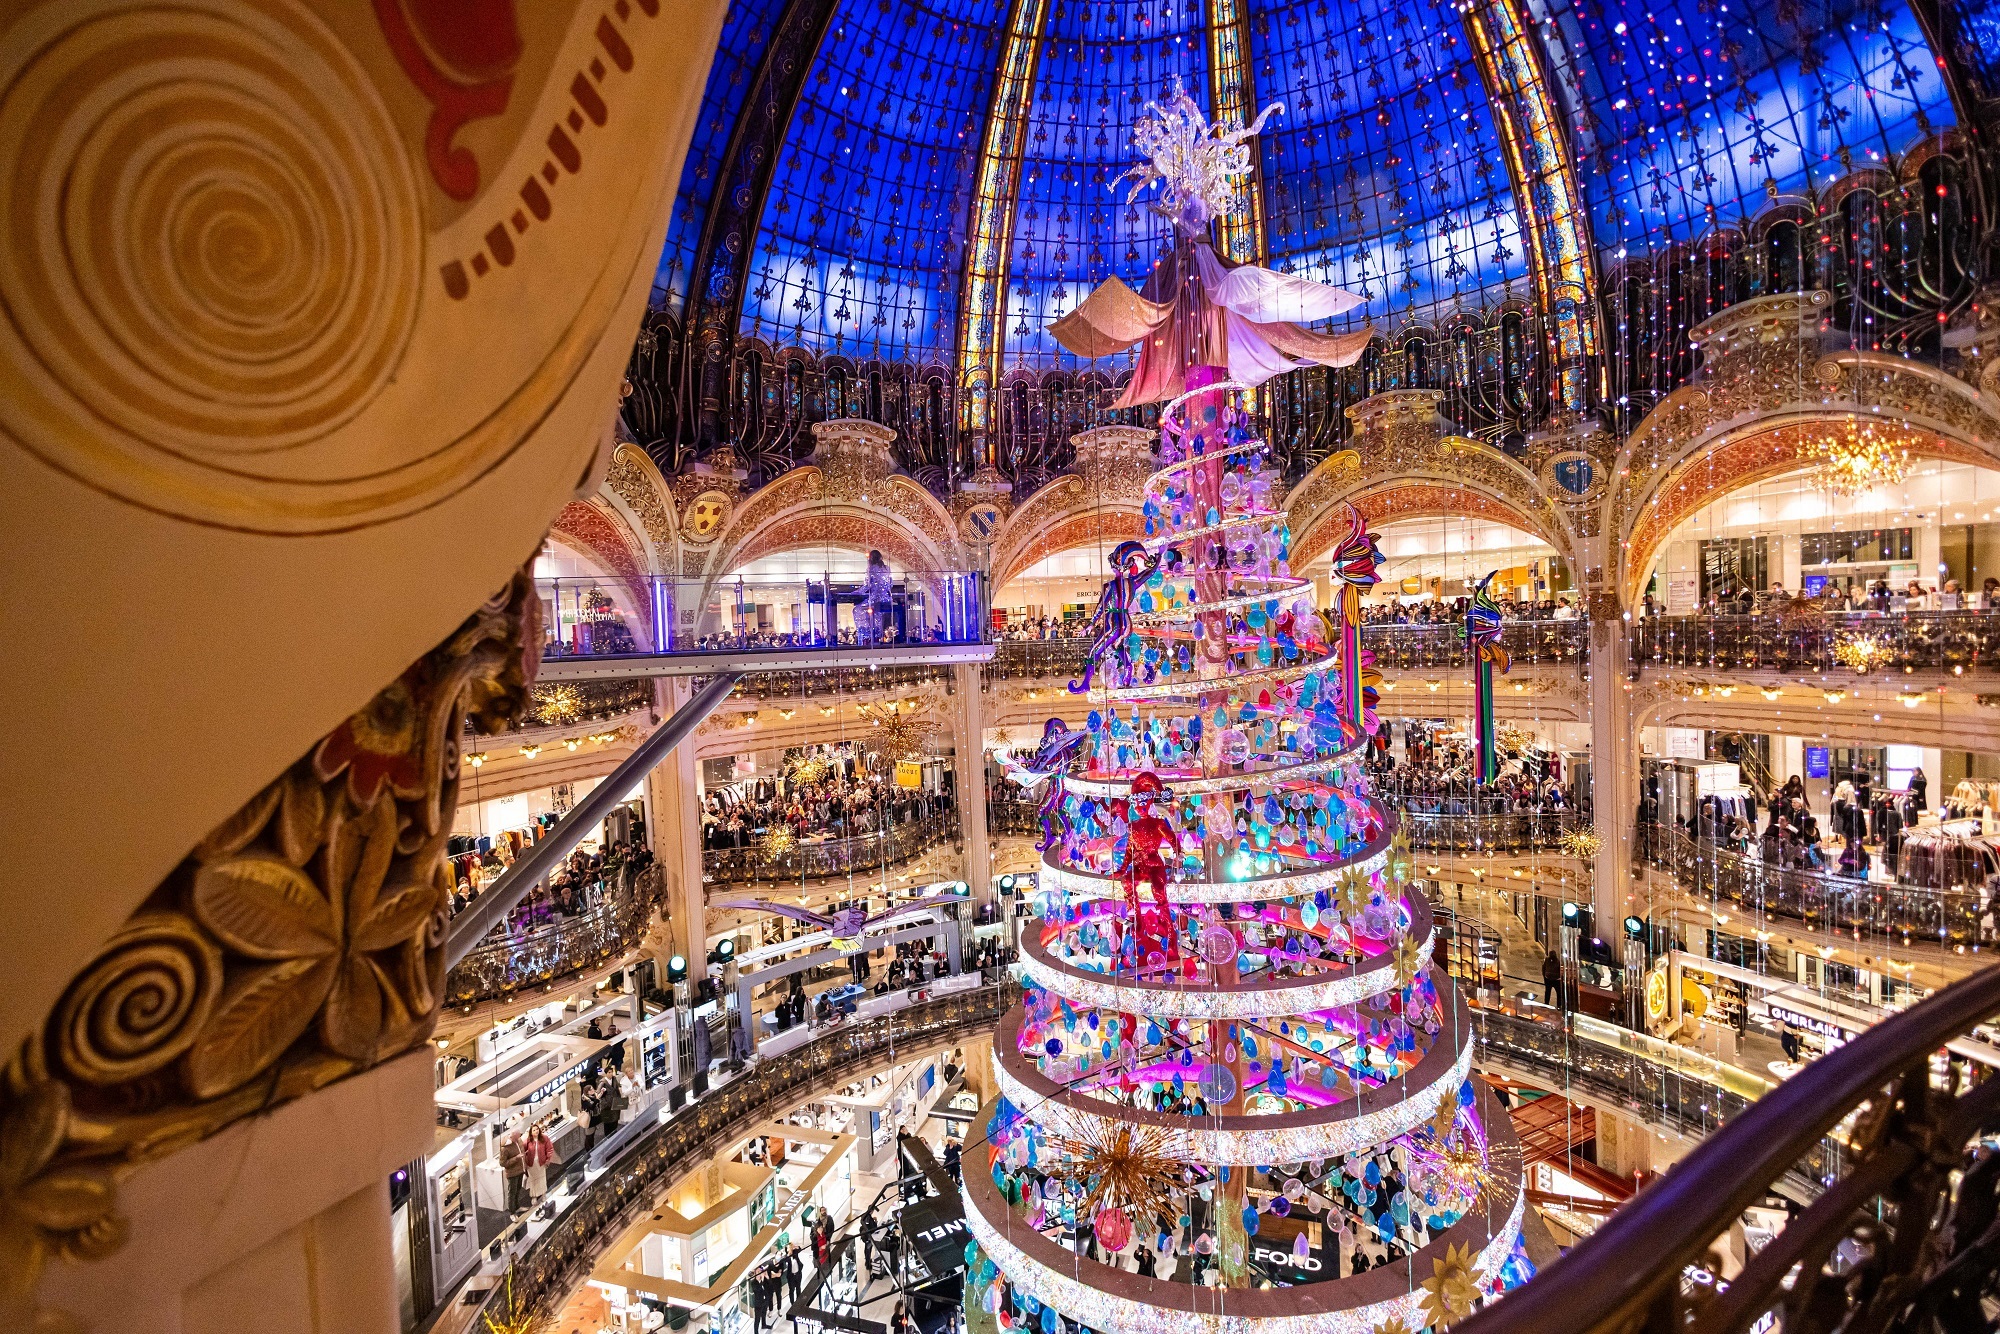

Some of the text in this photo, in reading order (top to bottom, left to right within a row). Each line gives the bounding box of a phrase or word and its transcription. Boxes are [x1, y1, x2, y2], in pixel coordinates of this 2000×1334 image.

[1771, 1007, 1839, 1039] GUERLAIN
[530, 1059, 589, 1102] GIVENCHY
[780, 1189, 809, 1212] MER
